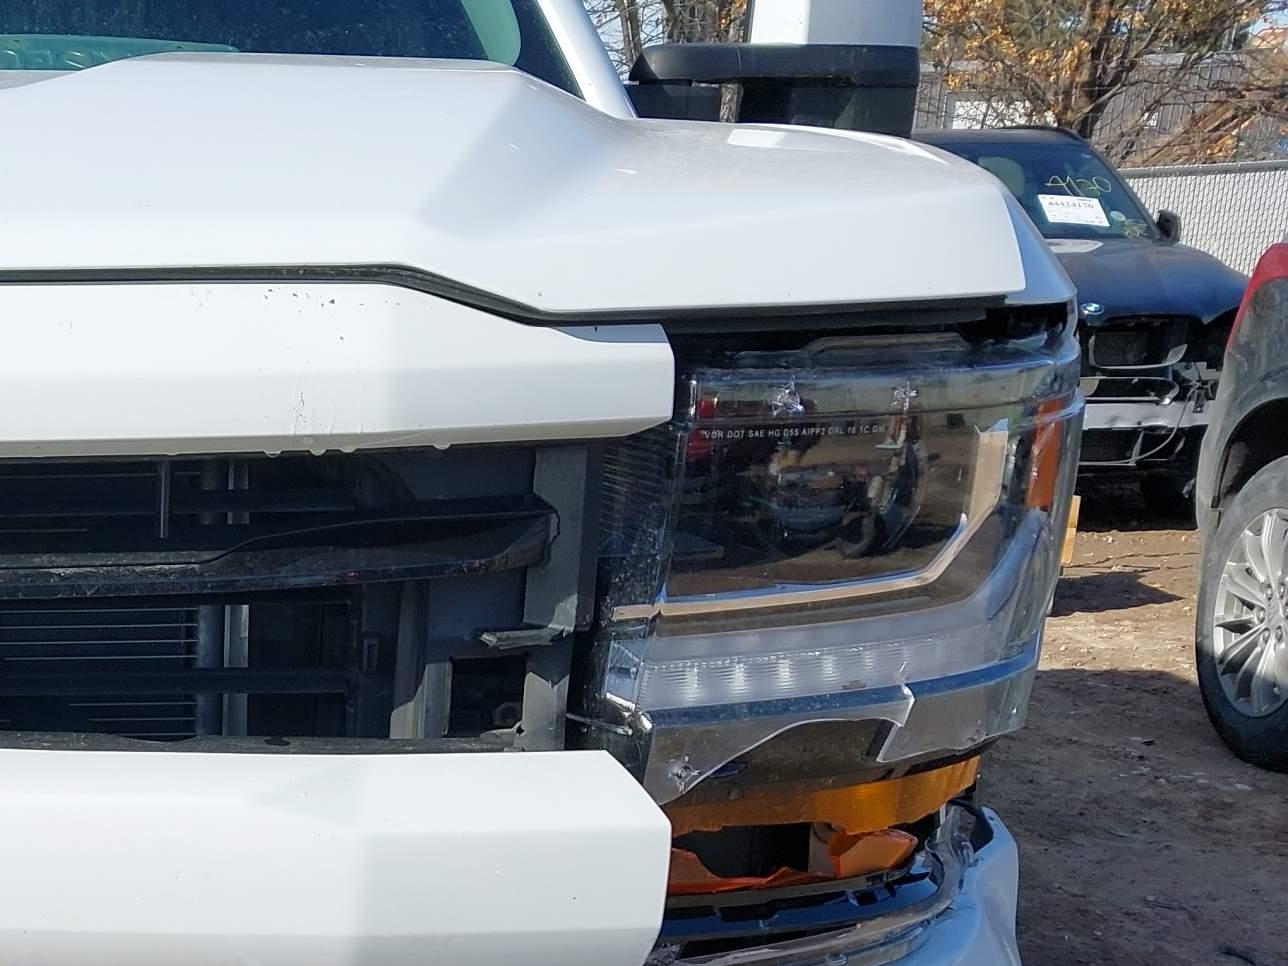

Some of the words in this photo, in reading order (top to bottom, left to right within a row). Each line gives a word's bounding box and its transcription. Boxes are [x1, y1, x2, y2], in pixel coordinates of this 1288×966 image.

[704, 429, 724, 439] VOR
[727, 429, 745, 439] DOT
[748, 429, 765, 438] SAE
